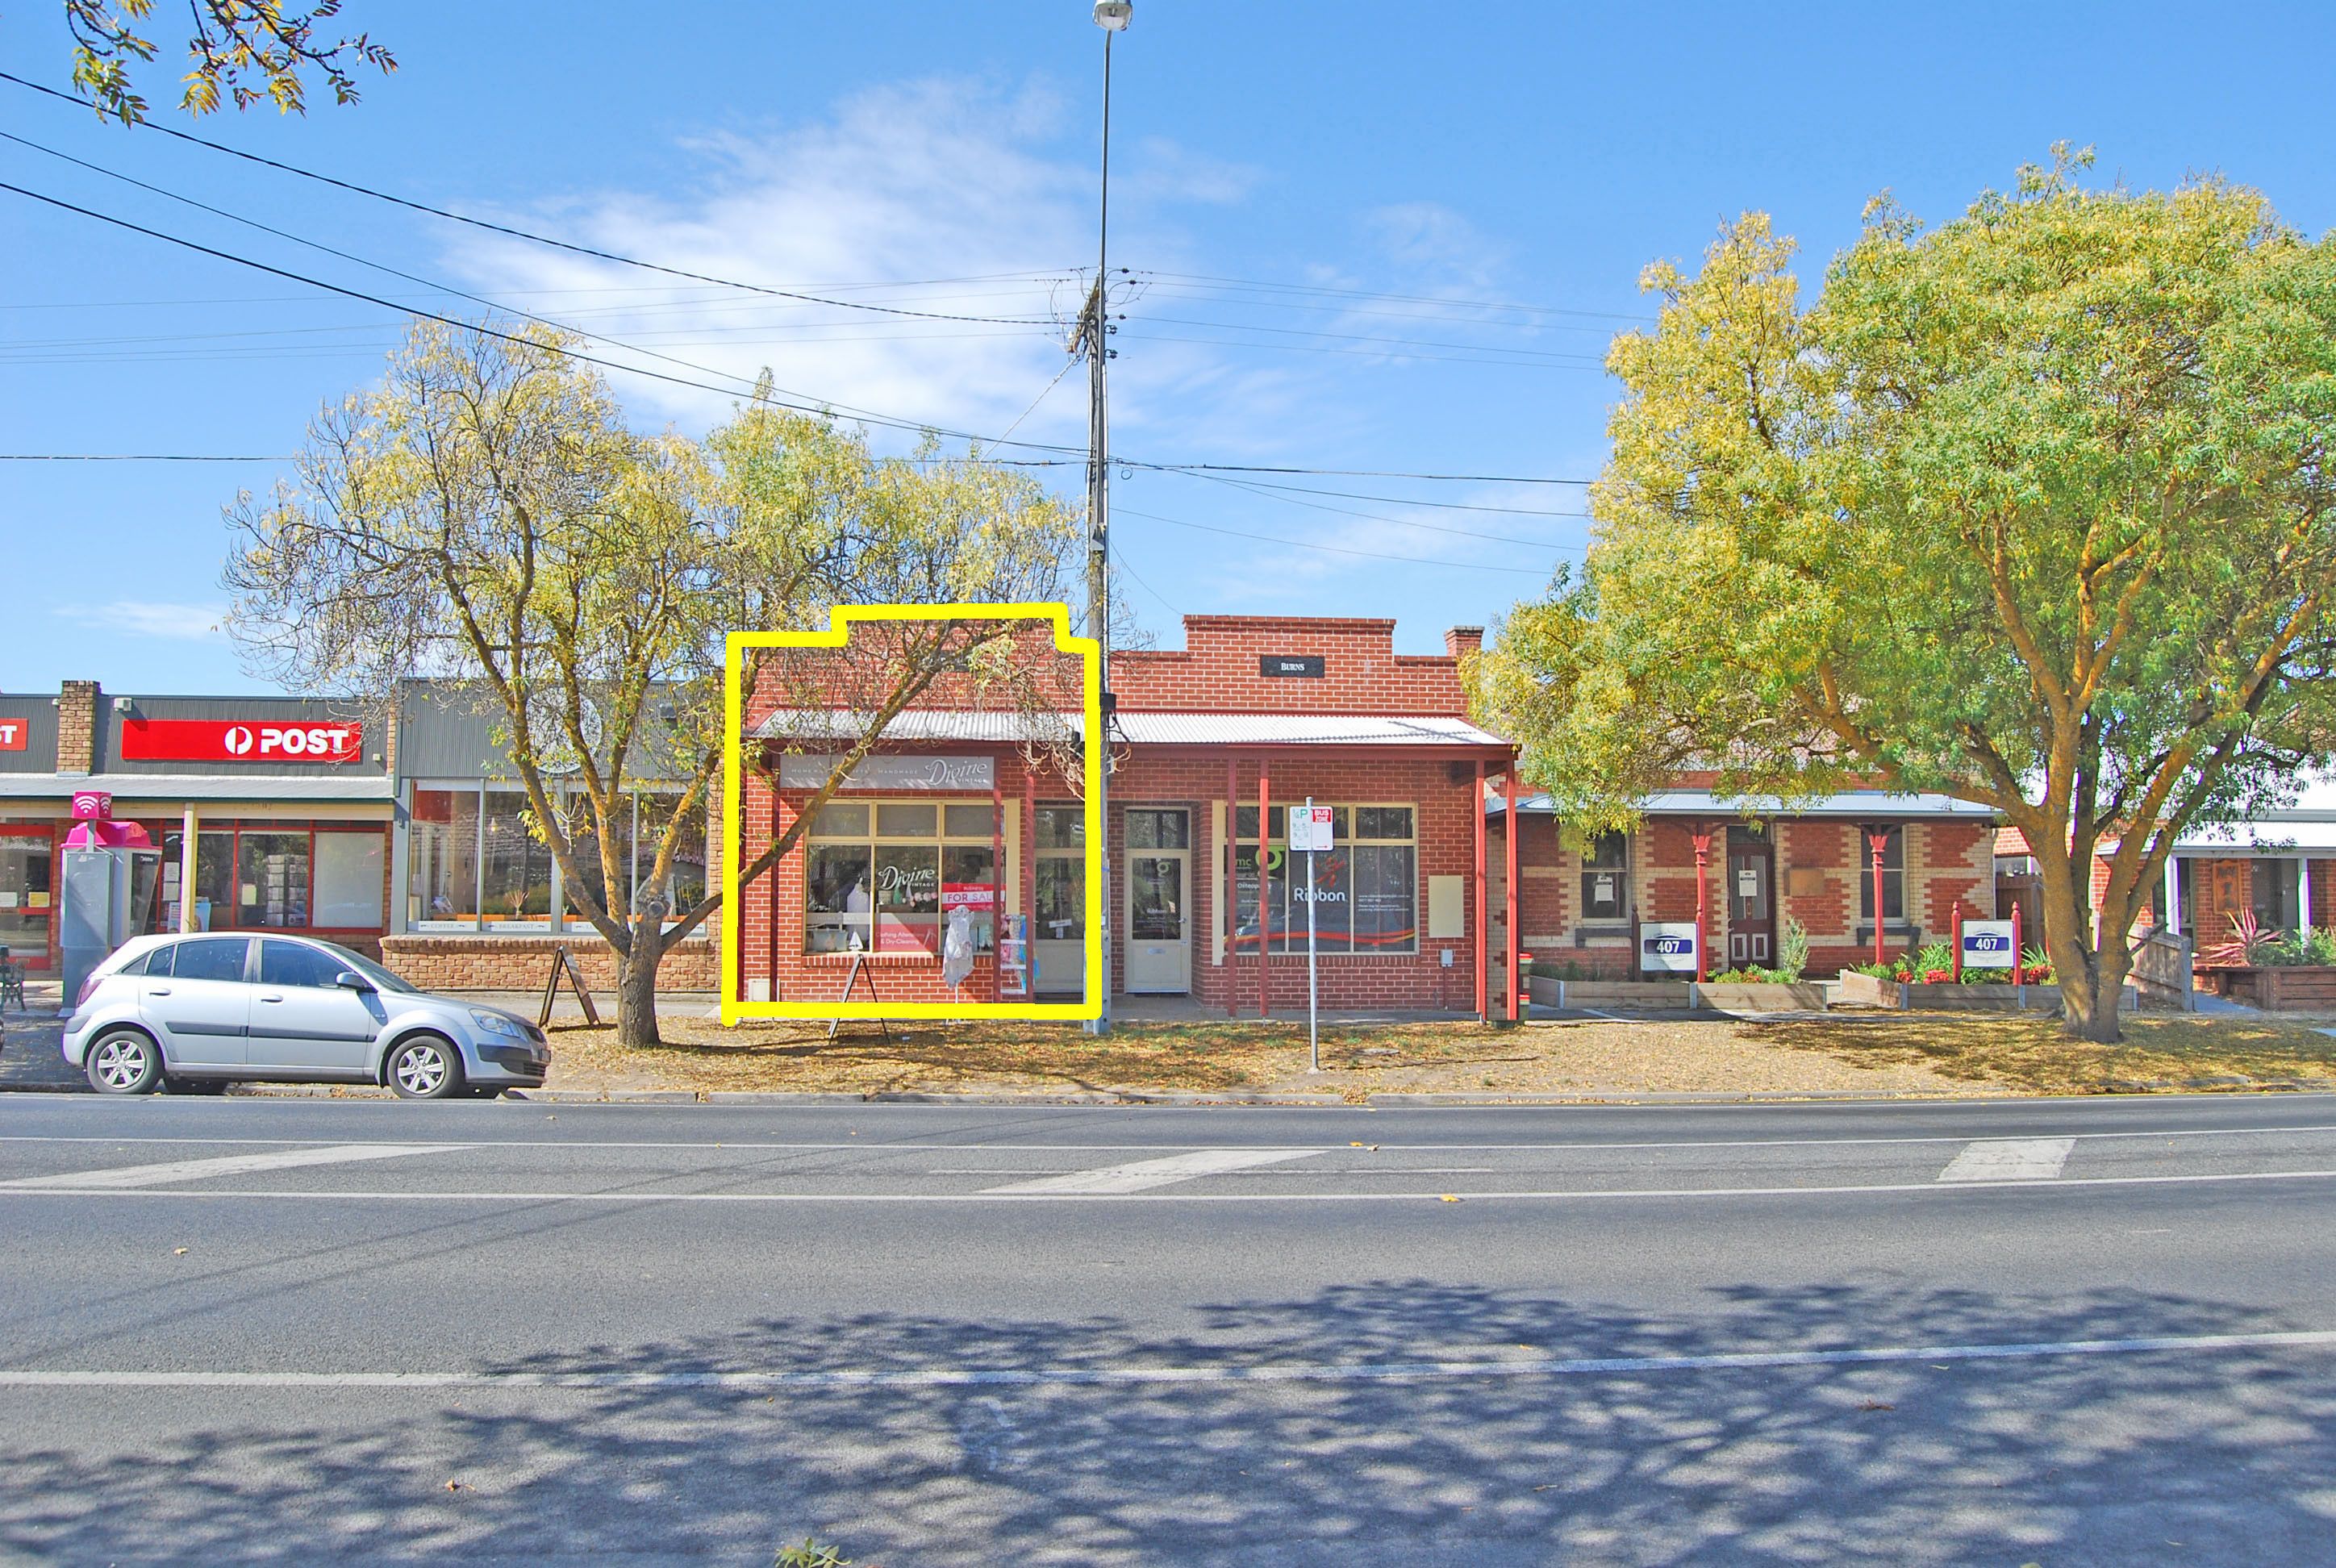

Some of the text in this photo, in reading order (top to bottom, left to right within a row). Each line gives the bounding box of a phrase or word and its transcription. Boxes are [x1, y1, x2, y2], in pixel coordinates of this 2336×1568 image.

[1281, 662, 1305, 671] BURNS
[261, 728, 348, 754] POST
[924, 759, 988, 786] Divine
[878, 866, 935, 890] Divine
[948, 893, 993, 902] FOR SAL
[1656, 940, 1680, 953] 407
[1975, 938, 1998, 950] 407
